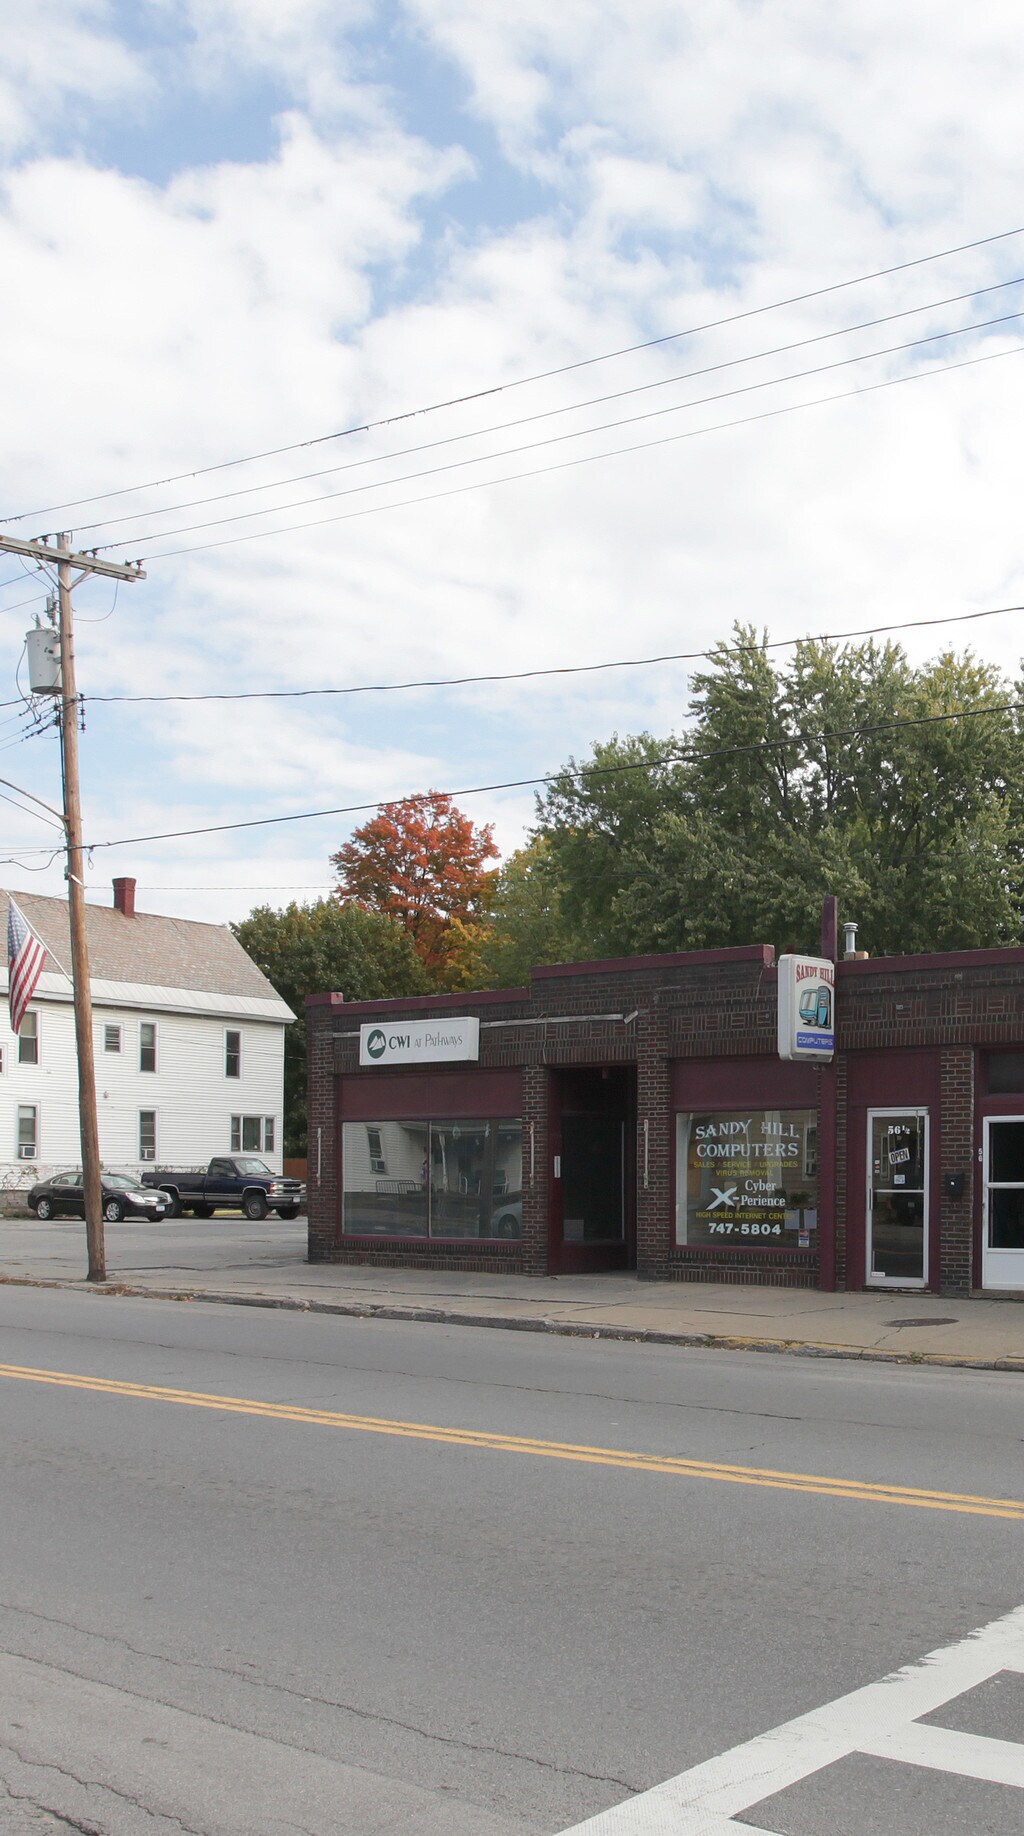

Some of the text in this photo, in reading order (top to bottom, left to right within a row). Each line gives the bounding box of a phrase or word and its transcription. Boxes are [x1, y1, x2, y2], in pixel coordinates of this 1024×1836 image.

[796, 964, 835, 989] SANDY HILL
[389, 1035, 410, 1050] CWI
[798, 1036, 833, 1046] COMPUTERS
[695, 1119, 800, 1140] SANDY HILL
[696, 1142, 799, 1157] COMPUTERS
[890, 1149, 909, 1163] OPEN
[693, 1161, 716, 1169] SALES
[745, 1179, 777, 1194] Cyber
[695, 1211, 711, 1219] HIGH
[713, 1211, 733, 1219] SPEED
[735, 1211, 766, 1219] INTERNET
[708, 1222, 782, 1235] 747-5804
